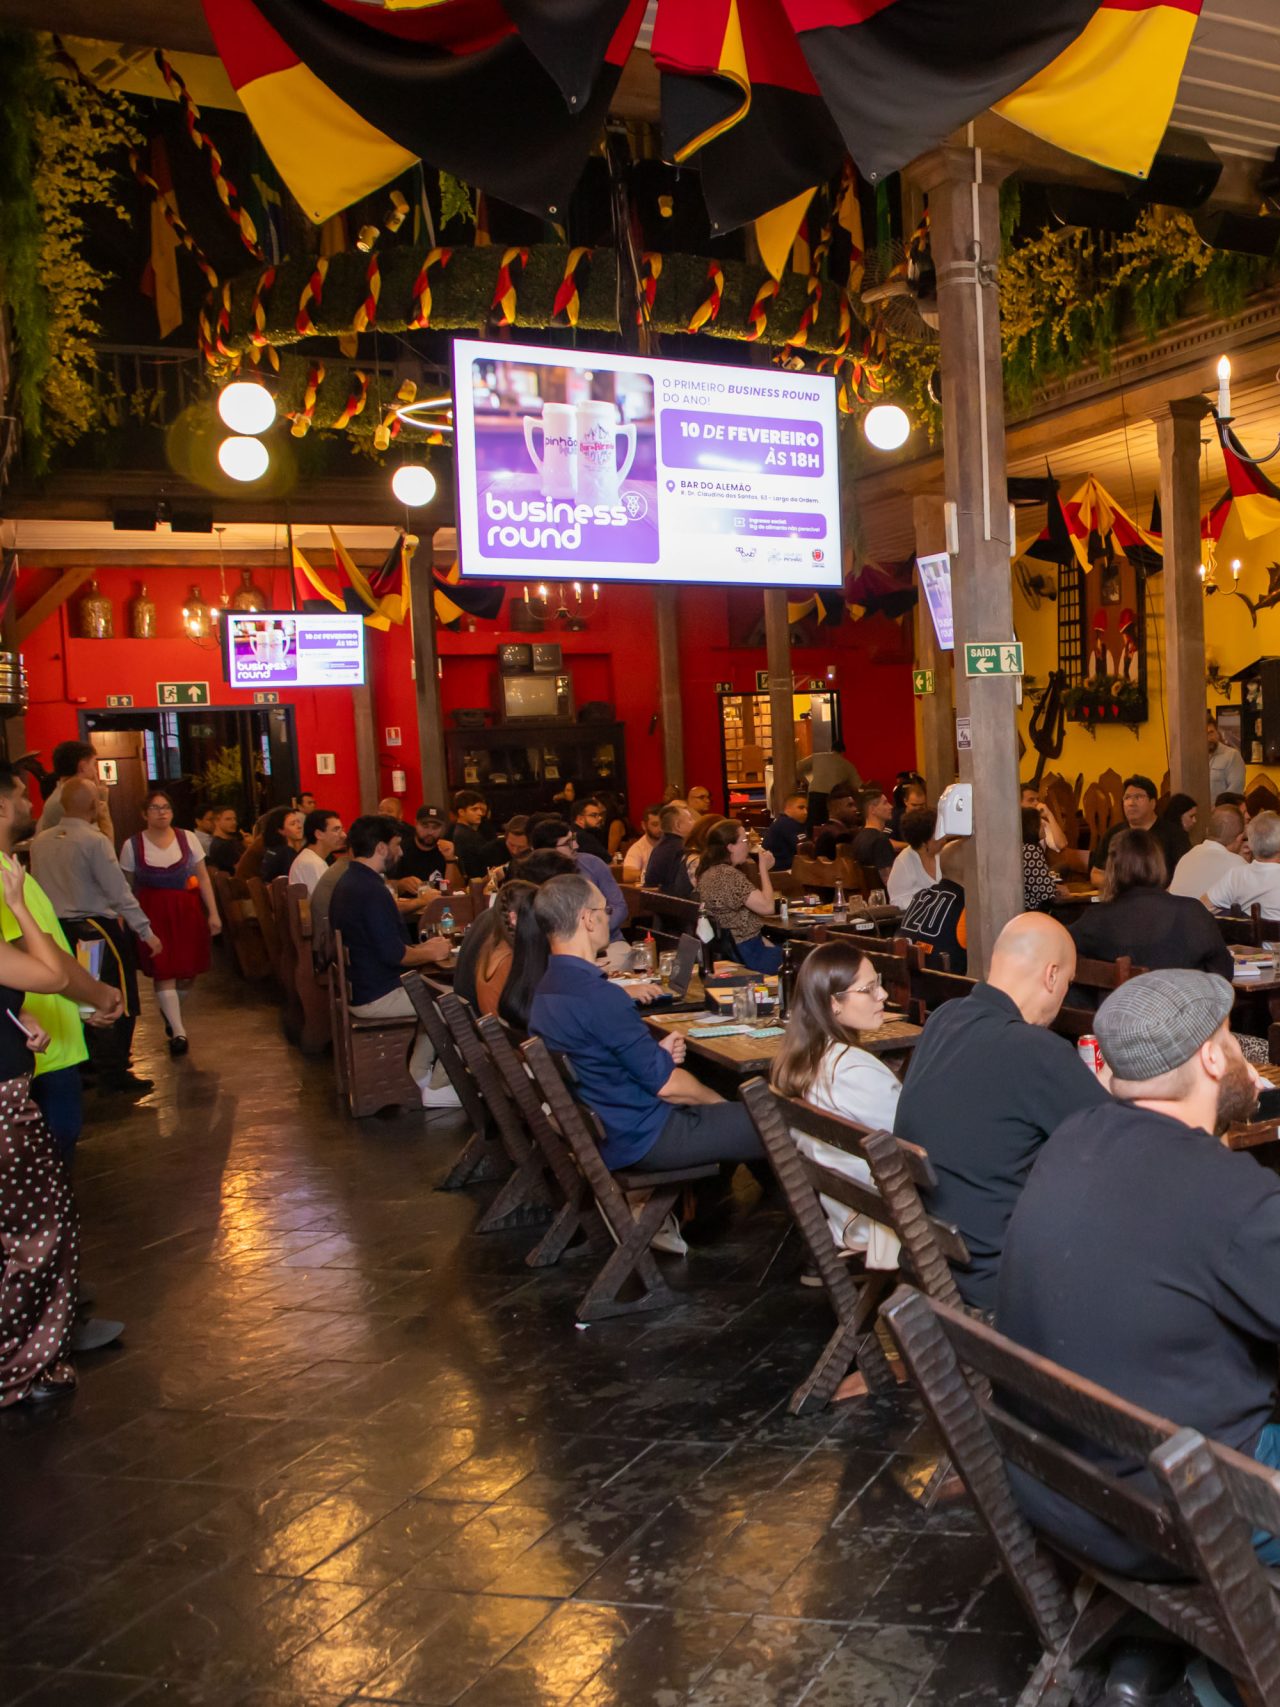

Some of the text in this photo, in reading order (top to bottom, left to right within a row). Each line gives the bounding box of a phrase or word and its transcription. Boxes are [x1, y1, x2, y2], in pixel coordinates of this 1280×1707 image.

[662, 378, 820, 402] O PRIMEIRO BUSINESS ROUND
[663, 393, 711, 406] DO ANO!
[680, 421, 819, 448] 10 DE FEVEREIRO
[765, 447, 820, 468] ÀS 18H
[680, 480, 751, 492] BAR DO ALEMÃO
[486, 492, 628, 526] business
[487, 522, 581, 550] round
[970, 647, 997, 657] SAÍDA
[236, 660, 288, 671] business
[237, 669, 271, 679] round
